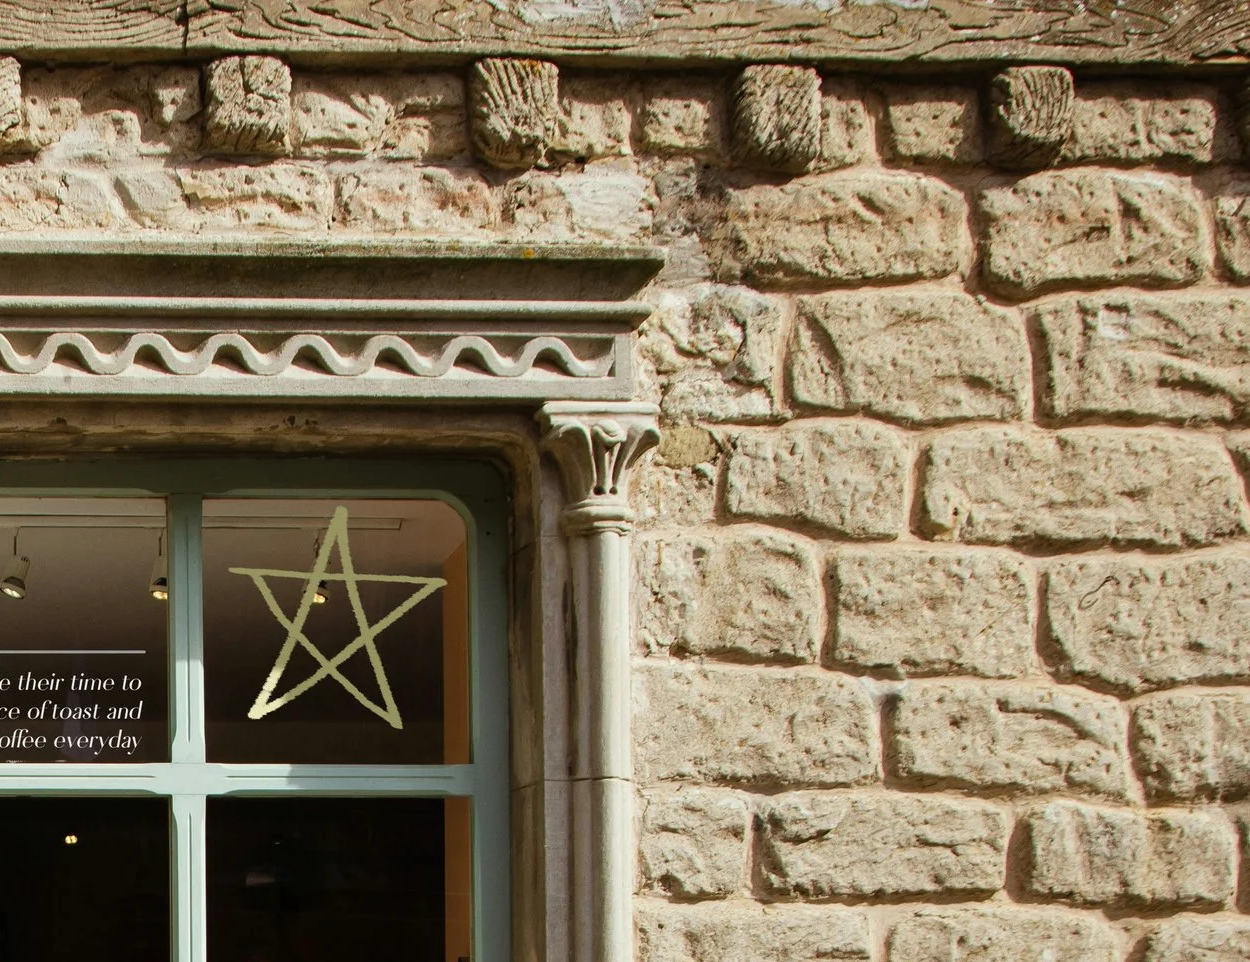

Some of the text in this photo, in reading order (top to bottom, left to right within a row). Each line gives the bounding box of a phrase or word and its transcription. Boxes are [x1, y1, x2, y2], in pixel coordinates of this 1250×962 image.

[17, 671, 65, 692] their
[70, 672, 115, 692] time
[121, 674, 143, 692] to
[27, 699, 53, 720] of
[52, 703, 100, 720] toast
[106, 699, 144, 720] and
[53, 728, 144, 756] everyday
